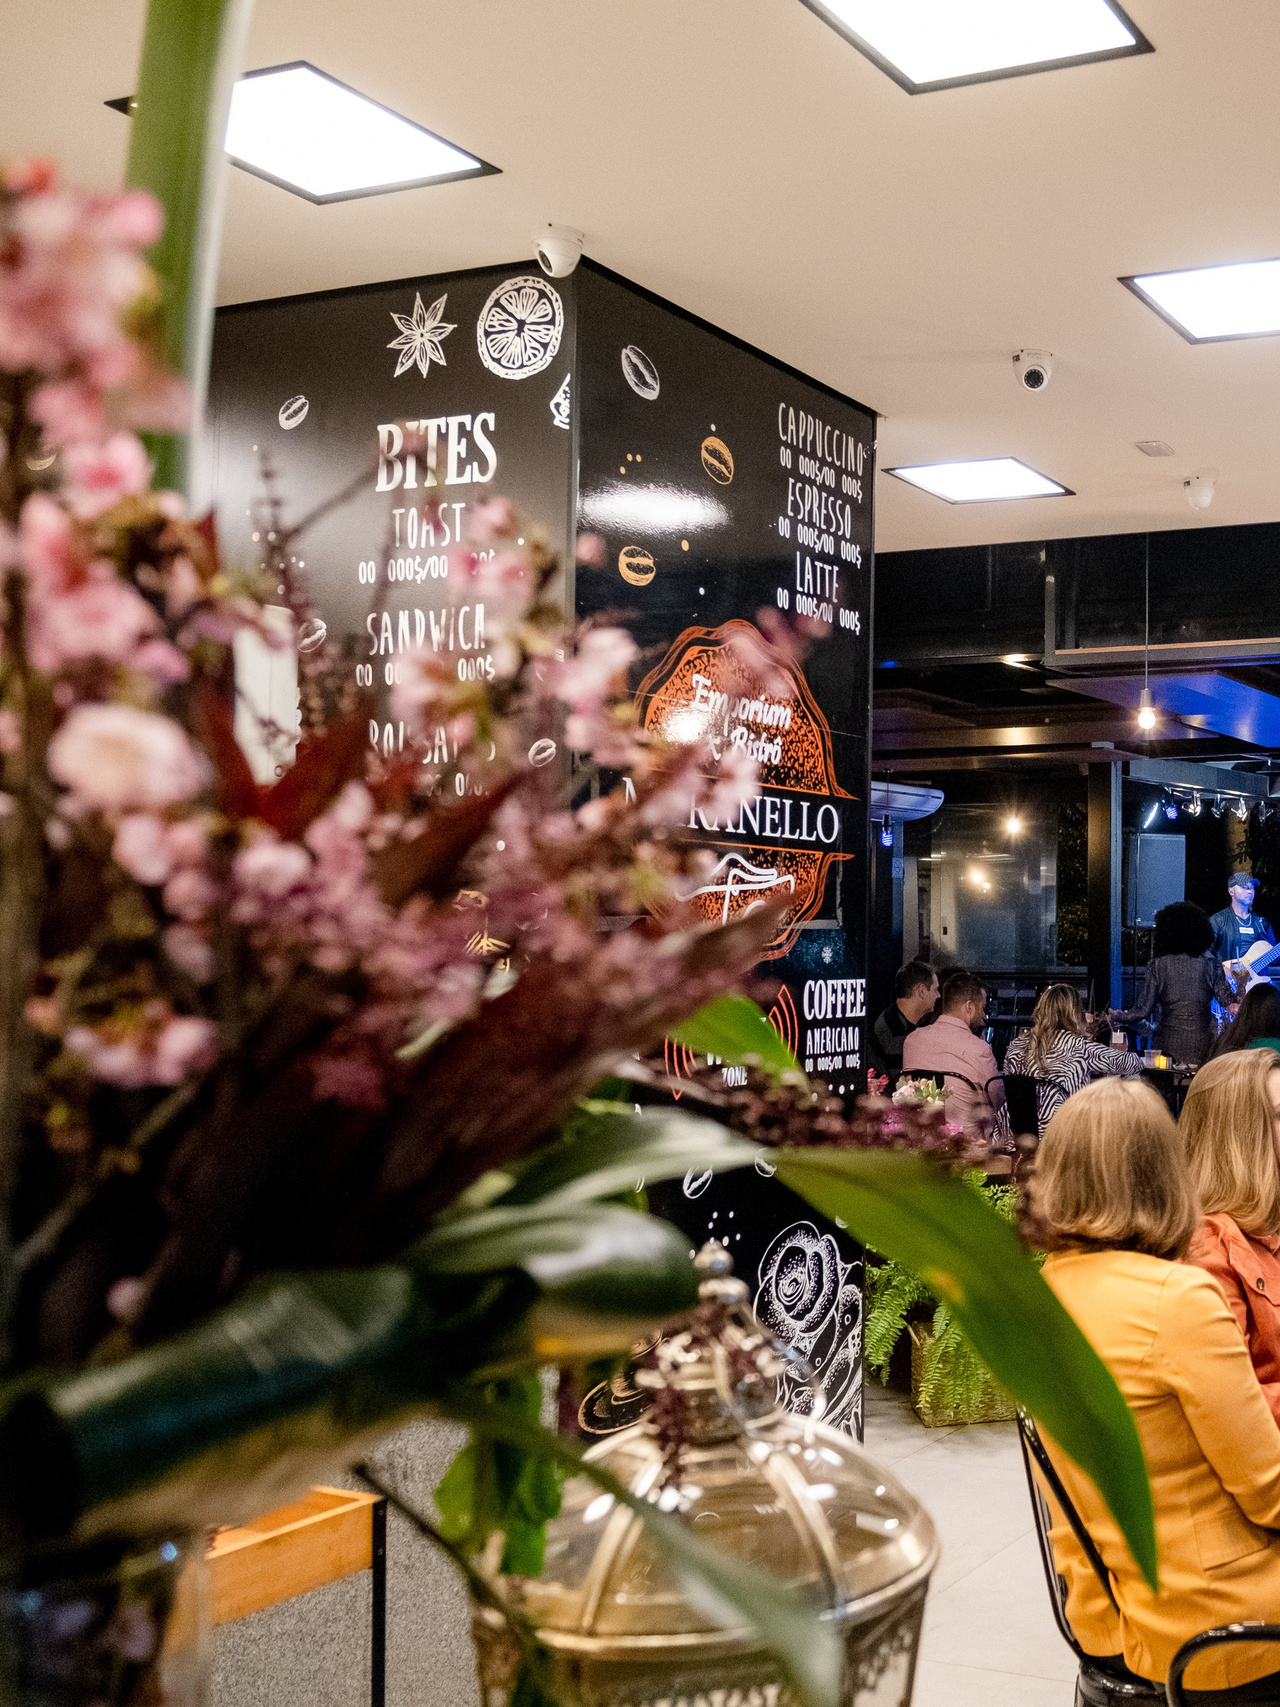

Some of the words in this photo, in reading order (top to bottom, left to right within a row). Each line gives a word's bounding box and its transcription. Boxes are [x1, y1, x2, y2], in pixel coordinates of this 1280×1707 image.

[375, 412, 498, 492] BITES
[778, 402, 863, 477] CAPPUCCINO
[780, 446, 792, 470] 00
[842, 474, 863, 504] 000$
[392, 502, 466, 550] TOAST
[787, 477, 852, 539] ESPRESSO
[778, 515, 791, 539] 00
[840, 540, 862, 570] 000$
[358, 560, 376, 585] 00
[796, 551, 839, 604] LATTE
[366, 602, 486, 656] SANDWICH
[777, 587, 790, 611] 00
[839, 607, 861, 636] 000$
[803, 978, 867, 1021] COFFEE
[806, 1026, 860, 1056] AMERICANO
[721, 1065, 748, 1087] ZONE
